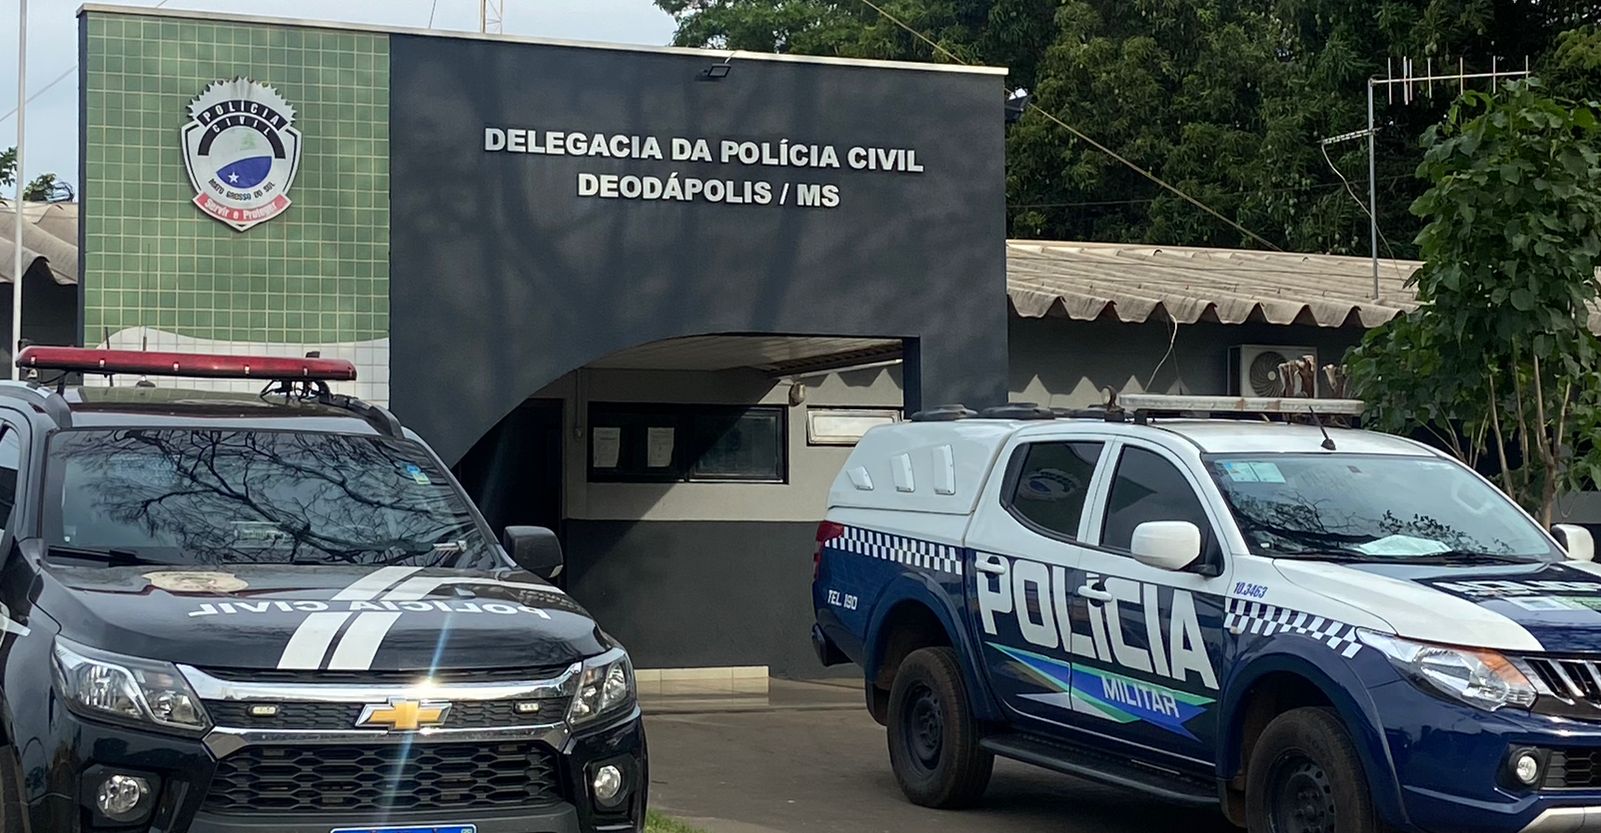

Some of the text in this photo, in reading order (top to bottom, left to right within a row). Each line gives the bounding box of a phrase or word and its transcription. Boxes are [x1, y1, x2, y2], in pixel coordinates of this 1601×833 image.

[212, 116, 271, 136] CIVIL
[484, 127, 925, 173] DELEGACIA DA POLÍCIA CIVIL
[577, 172, 841, 208] DEODÁPOLIS / MS
[204, 198, 230, 217] Servir
[843, 593, 858, 611] 190
[1101, 674, 1180, 719] MILITAR
